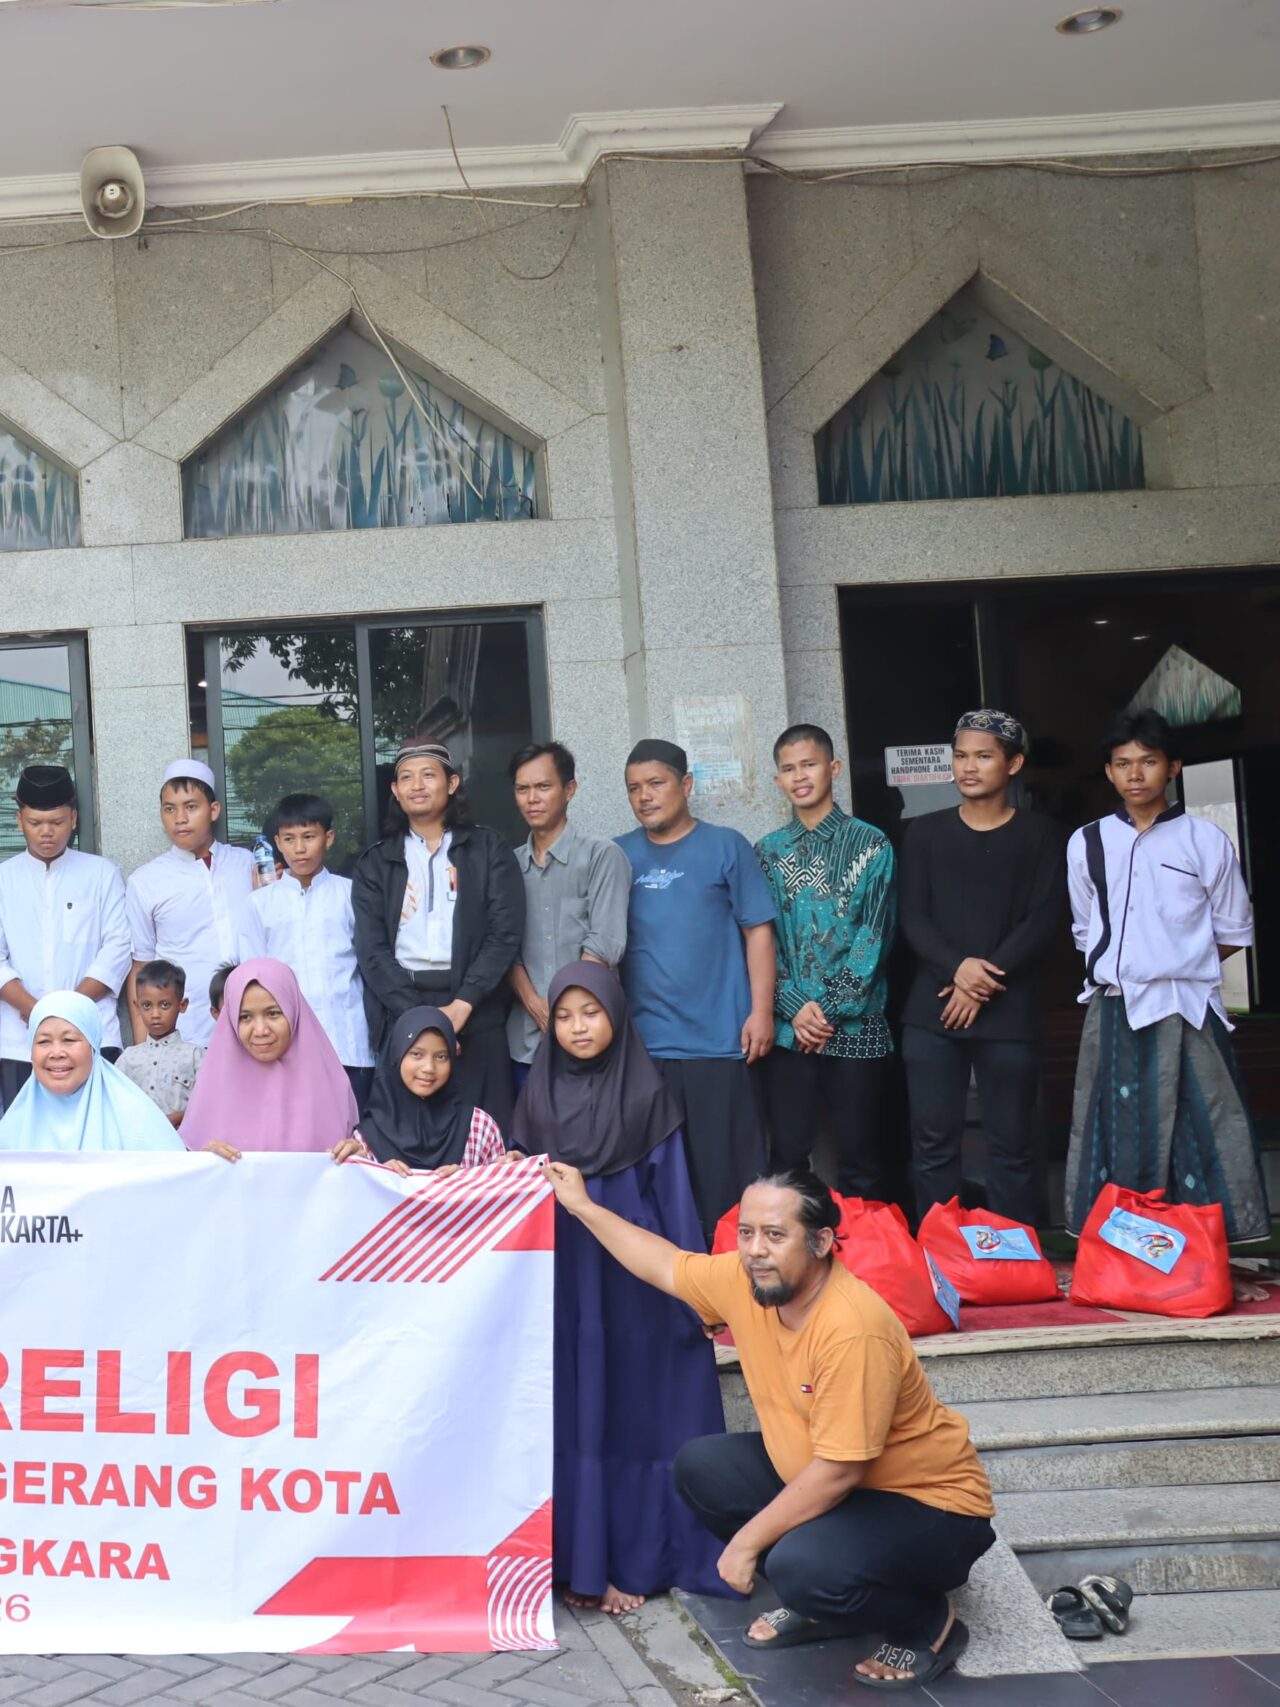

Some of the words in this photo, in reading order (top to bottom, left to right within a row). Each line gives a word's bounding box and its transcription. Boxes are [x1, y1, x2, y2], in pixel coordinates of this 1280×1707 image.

[896, 748, 921, 757] TERIMA
[925, 747, 945, 756] KASIH
[901, 756, 941, 765] SEMENTARA
[891, 765, 930, 774] HANDPHONE
[240, 1467, 401, 1516] KOTA
